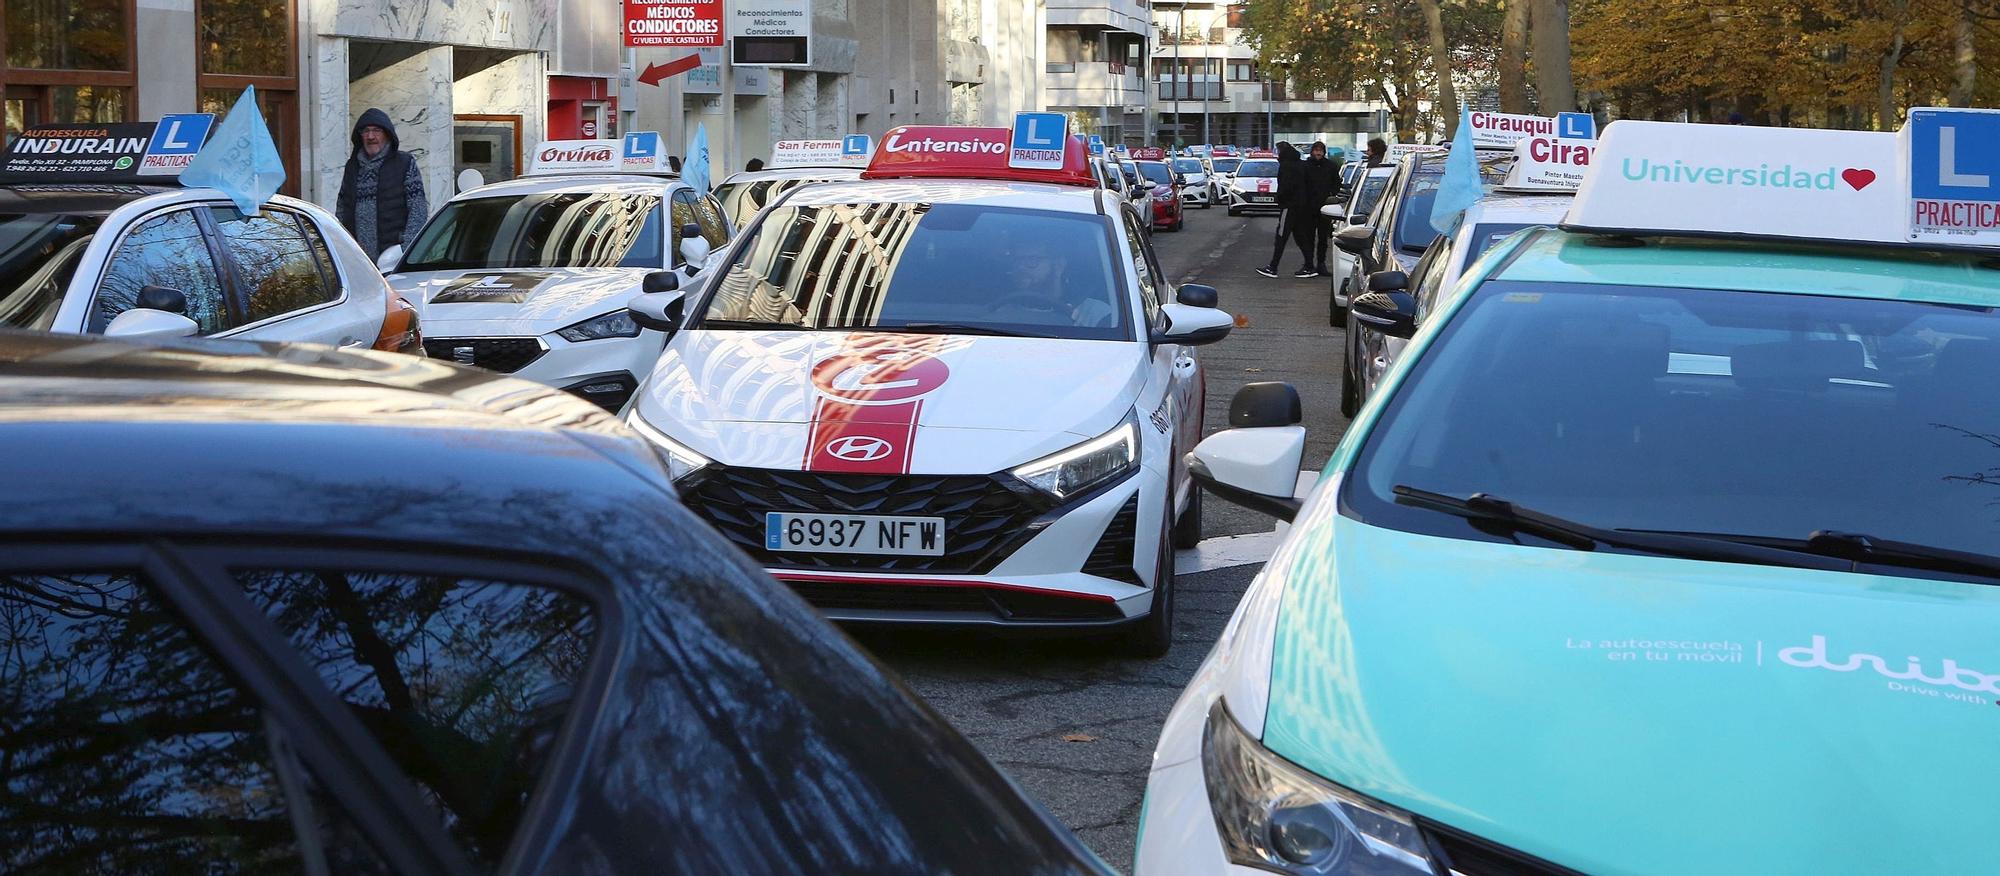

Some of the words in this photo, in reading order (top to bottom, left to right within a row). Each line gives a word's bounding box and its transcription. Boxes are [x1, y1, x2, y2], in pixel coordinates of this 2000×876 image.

[647, 5, 695, 19] MÉDICOS
[629, 19, 718, 33] CONDUCTORES
[754, 18, 787, 26] Médicos
[1027, 118, 1051, 145] L
[1471, 112, 1553, 136] Cirauqui
[1567, 117, 1583, 135] L
[23, 129, 108, 137] AUTOESCUELA
[162, 121, 189, 149] L
[13, 138, 147, 154] INDURAIN
[631, 137, 647, 155] L
[778, 142, 799, 150] San
[848, 139, 861, 152] L
[886, 128, 1006, 154] intensivo
[540, 147, 612, 162] Orvina
[1014, 150, 1061, 162] PRACTICAS
[1530, 138, 1596, 166] Cira
[1939, 126, 1990, 188] L
[144, 155, 194, 168] PRACTICAS
[624, 157, 654, 165] PRACTICAS
[1527, 177, 1564, 186] Buenaventura
[1622, 157, 1836, 191] Universidad
[788, 517, 866, 548] 6937
[879, 520, 937, 550] NFW
[1566, 637, 1591, 649] La
[1600, 639, 1743, 651] autoescuela
[1607, 651, 1636, 661] en
[1645, 651, 1669, 661] tu
[1677, 650, 1743, 663] móvil
[1887, 681, 1940, 697] Drive
[1944, 690, 1988, 705] with
